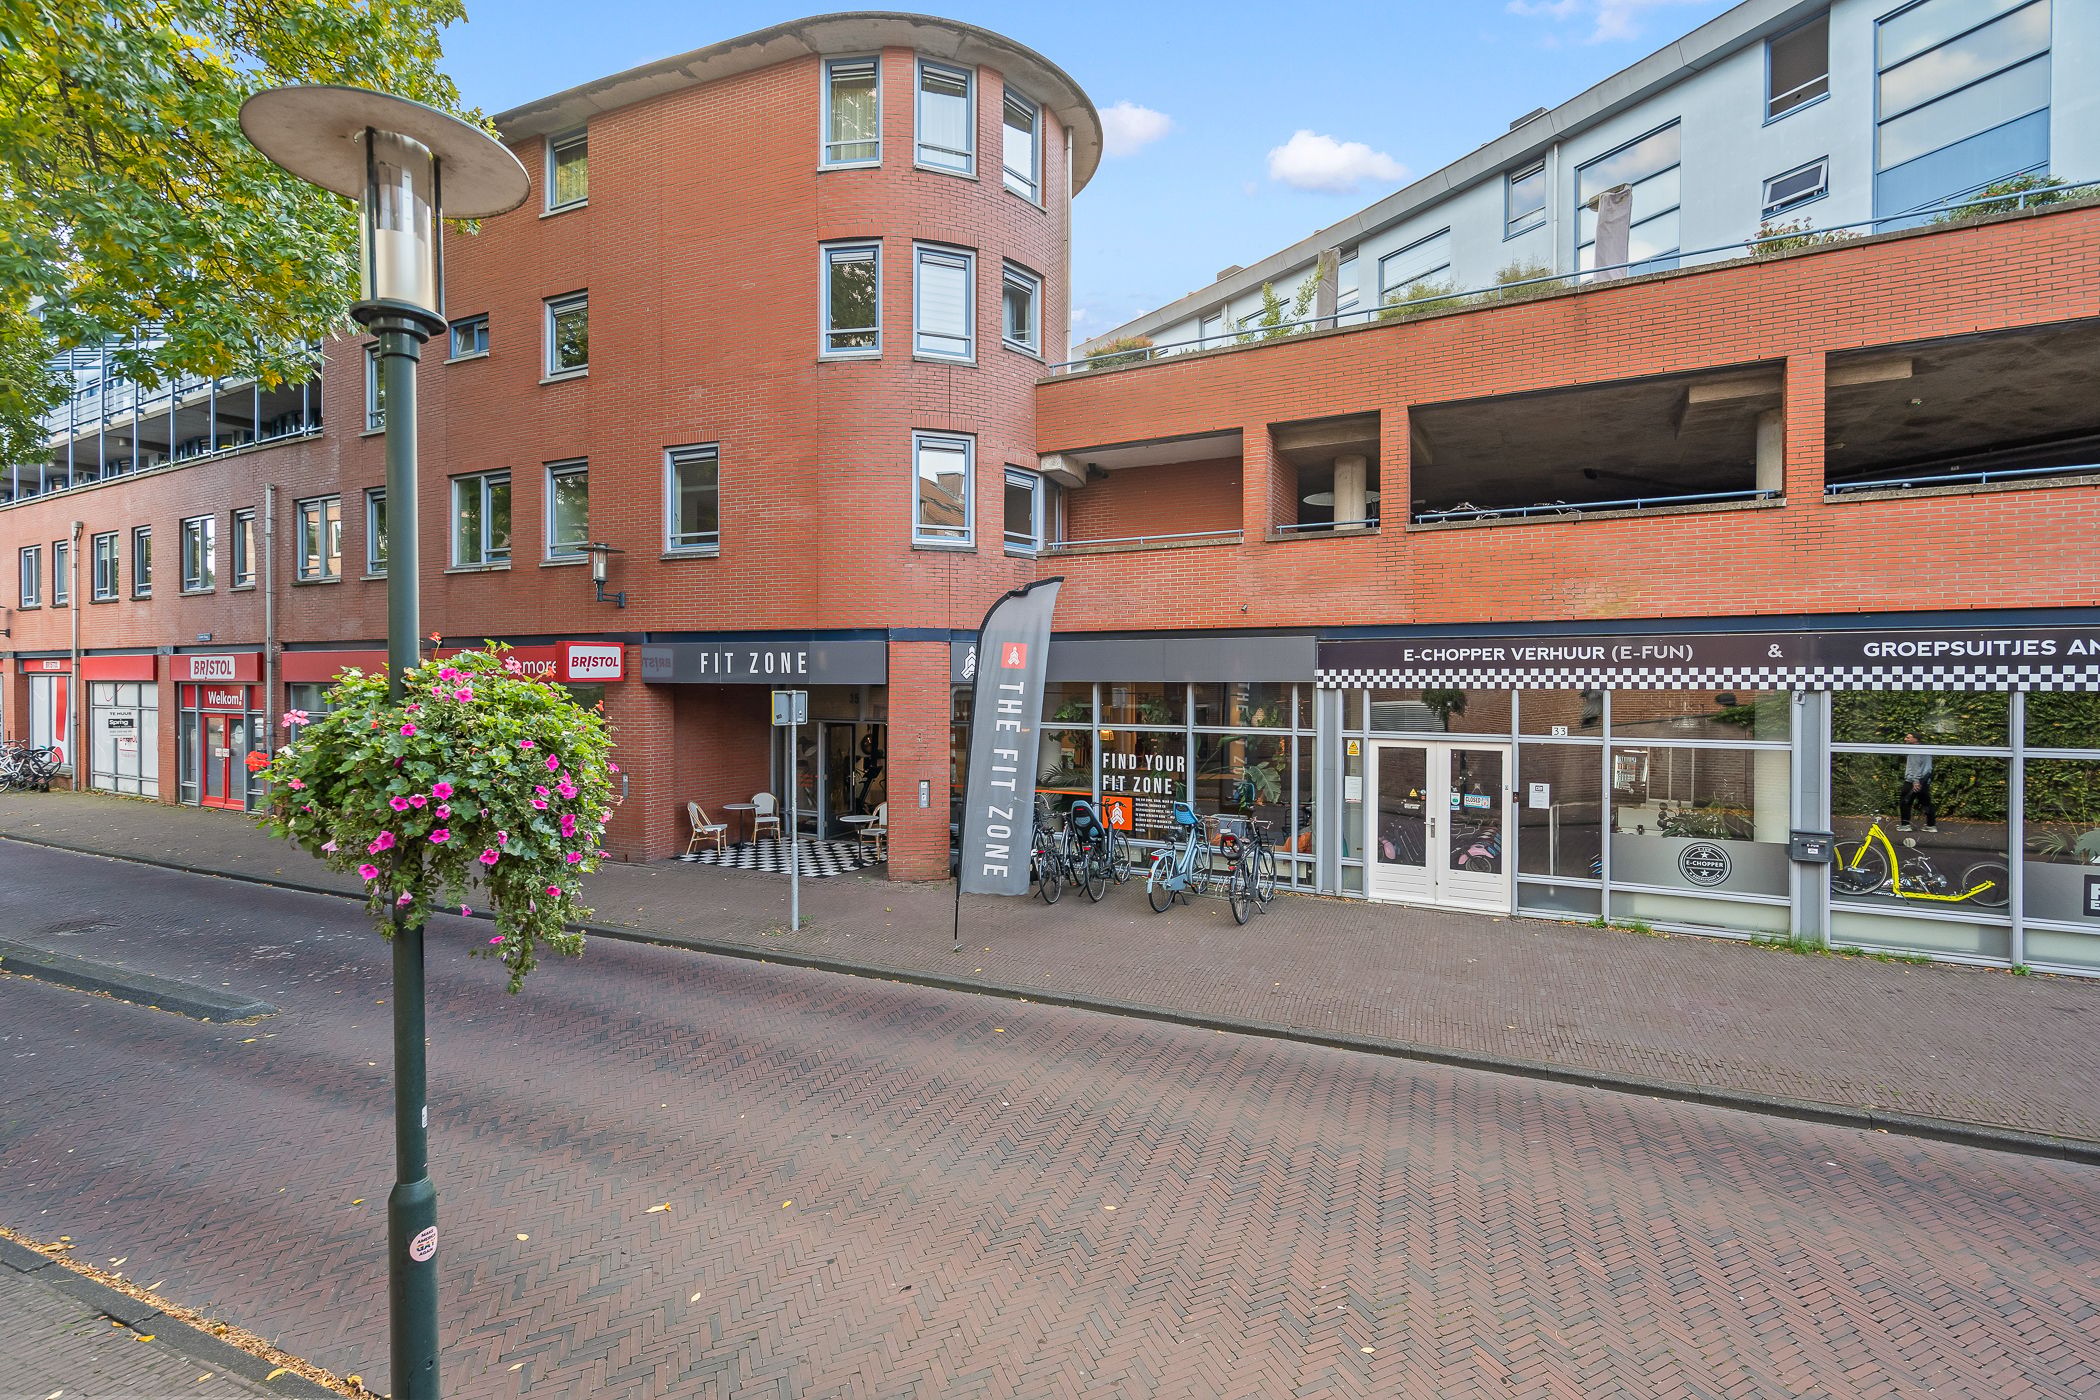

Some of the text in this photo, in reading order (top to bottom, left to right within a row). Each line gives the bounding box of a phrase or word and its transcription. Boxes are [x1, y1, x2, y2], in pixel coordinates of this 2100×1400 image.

[1403, 647, 1505, 662] E-CHOPPER
[1511, 645, 1605, 661] VERHUUR
[1611, 643, 1694, 662] (E-FUN)
[1766, 643, 1784, 658] &
[1863, 639, 2057, 657] GROEPSUITJES
[700, 651, 807, 674] FIT ZONE
[208, 689, 243, 706] Welkom!
[1553, 727, 1566, 736] 33
[1102, 752, 1185, 772] FIND YOUR
[982, 681, 1025, 878] THE FIT ZONE
[1102, 774, 1173, 794] FIT ZONE
[1685, 859, 1724, 868] E-CHOPPER
